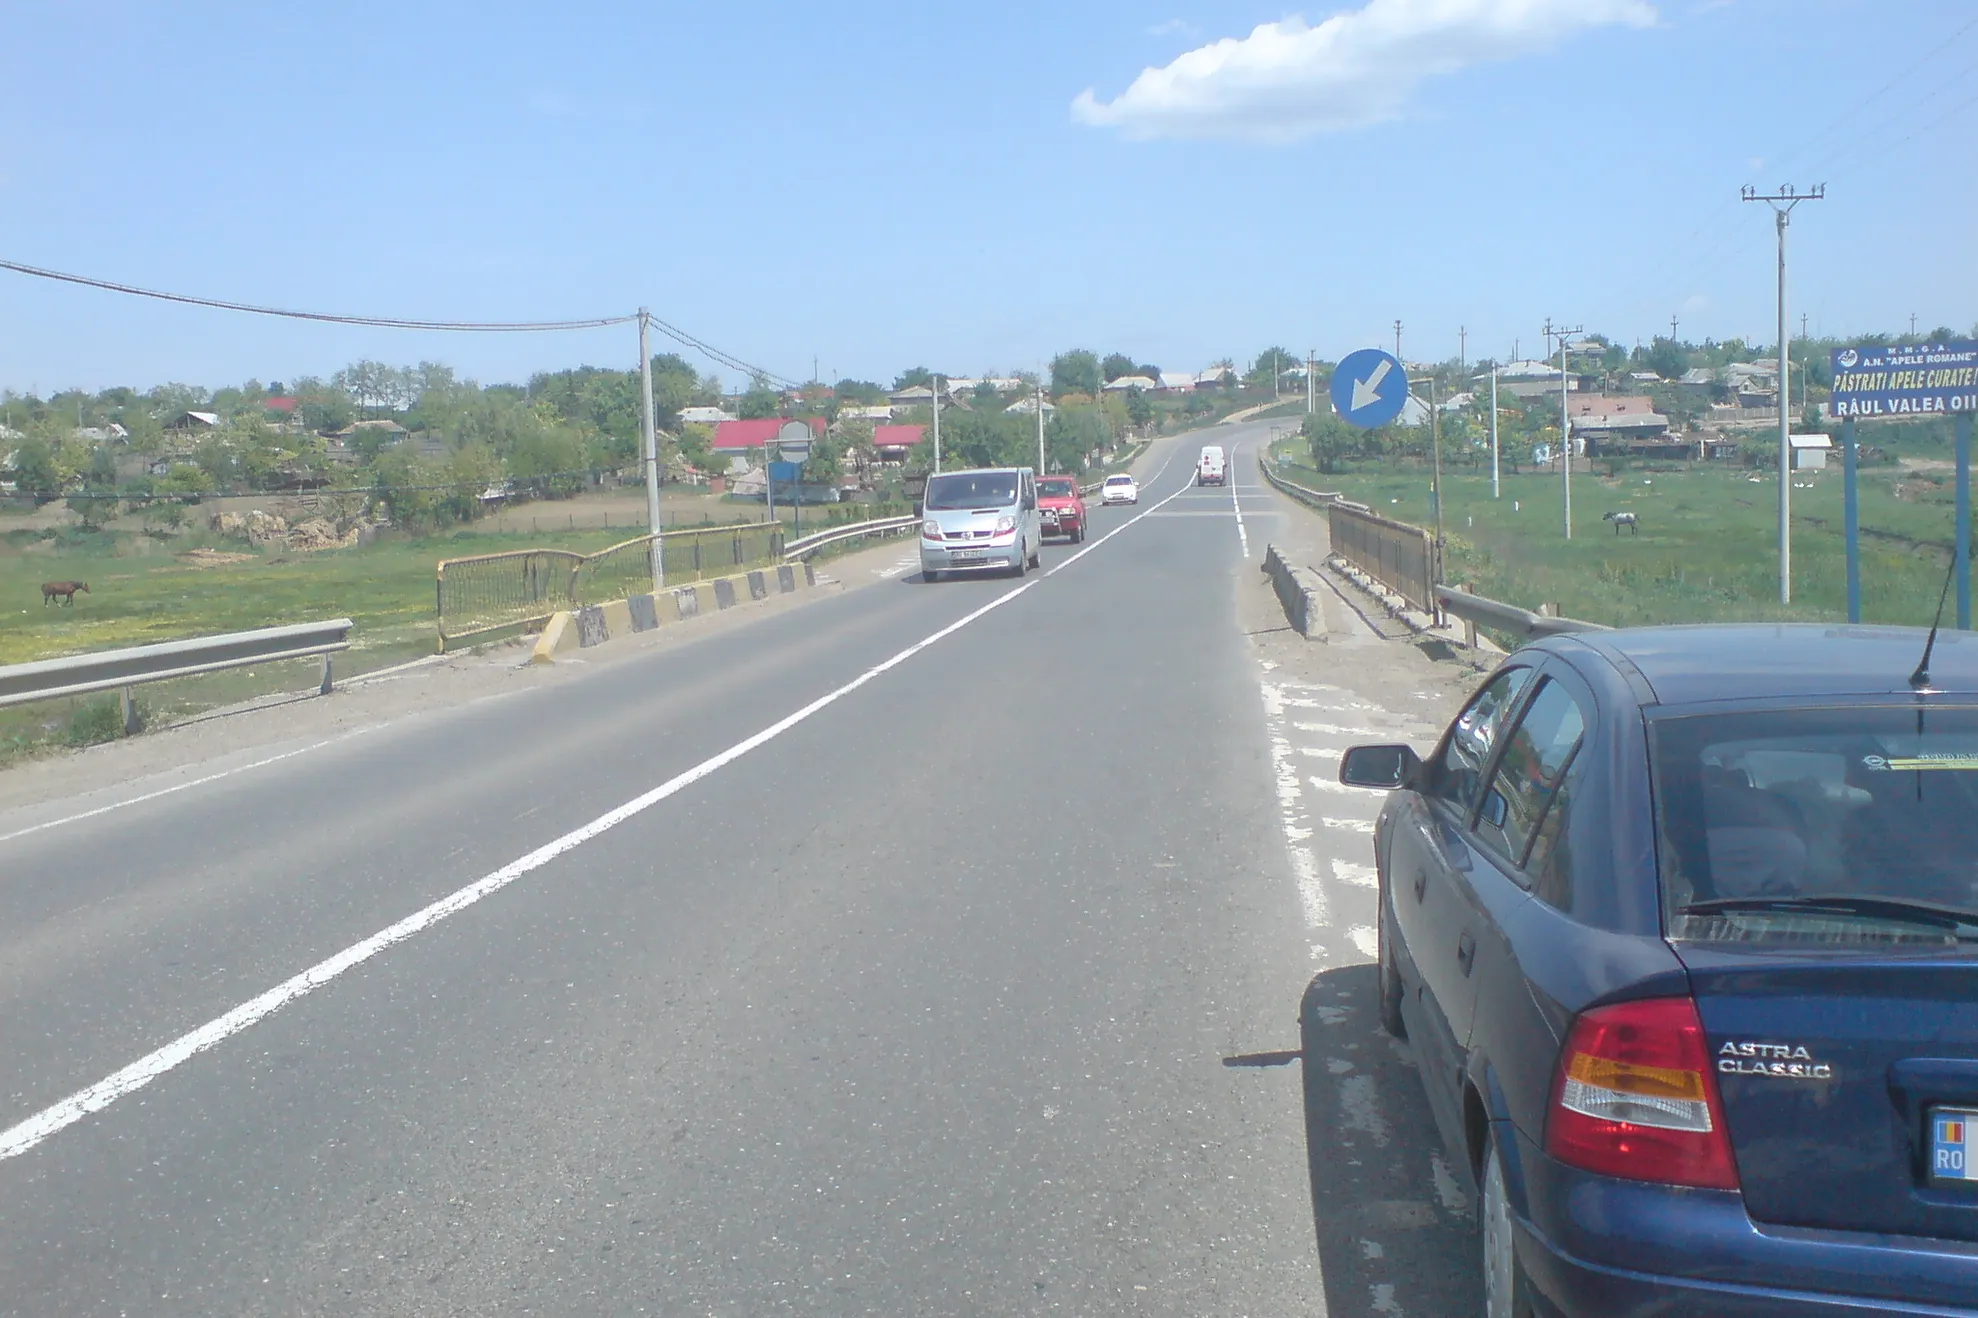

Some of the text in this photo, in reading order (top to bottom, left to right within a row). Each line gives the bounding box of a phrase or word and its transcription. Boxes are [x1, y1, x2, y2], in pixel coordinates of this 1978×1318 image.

[1863, 358, 1884, 367] A.N.
[1888, 370, 1925, 390] APELE
[1837, 395, 1977, 416] RÂUL VALEA OII
[1718, 1041, 1811, 1061] ASTRA
[1718, 1060, 1832, 1078] CLASSIC
[1936, 1149, 1963, 1170] RO
